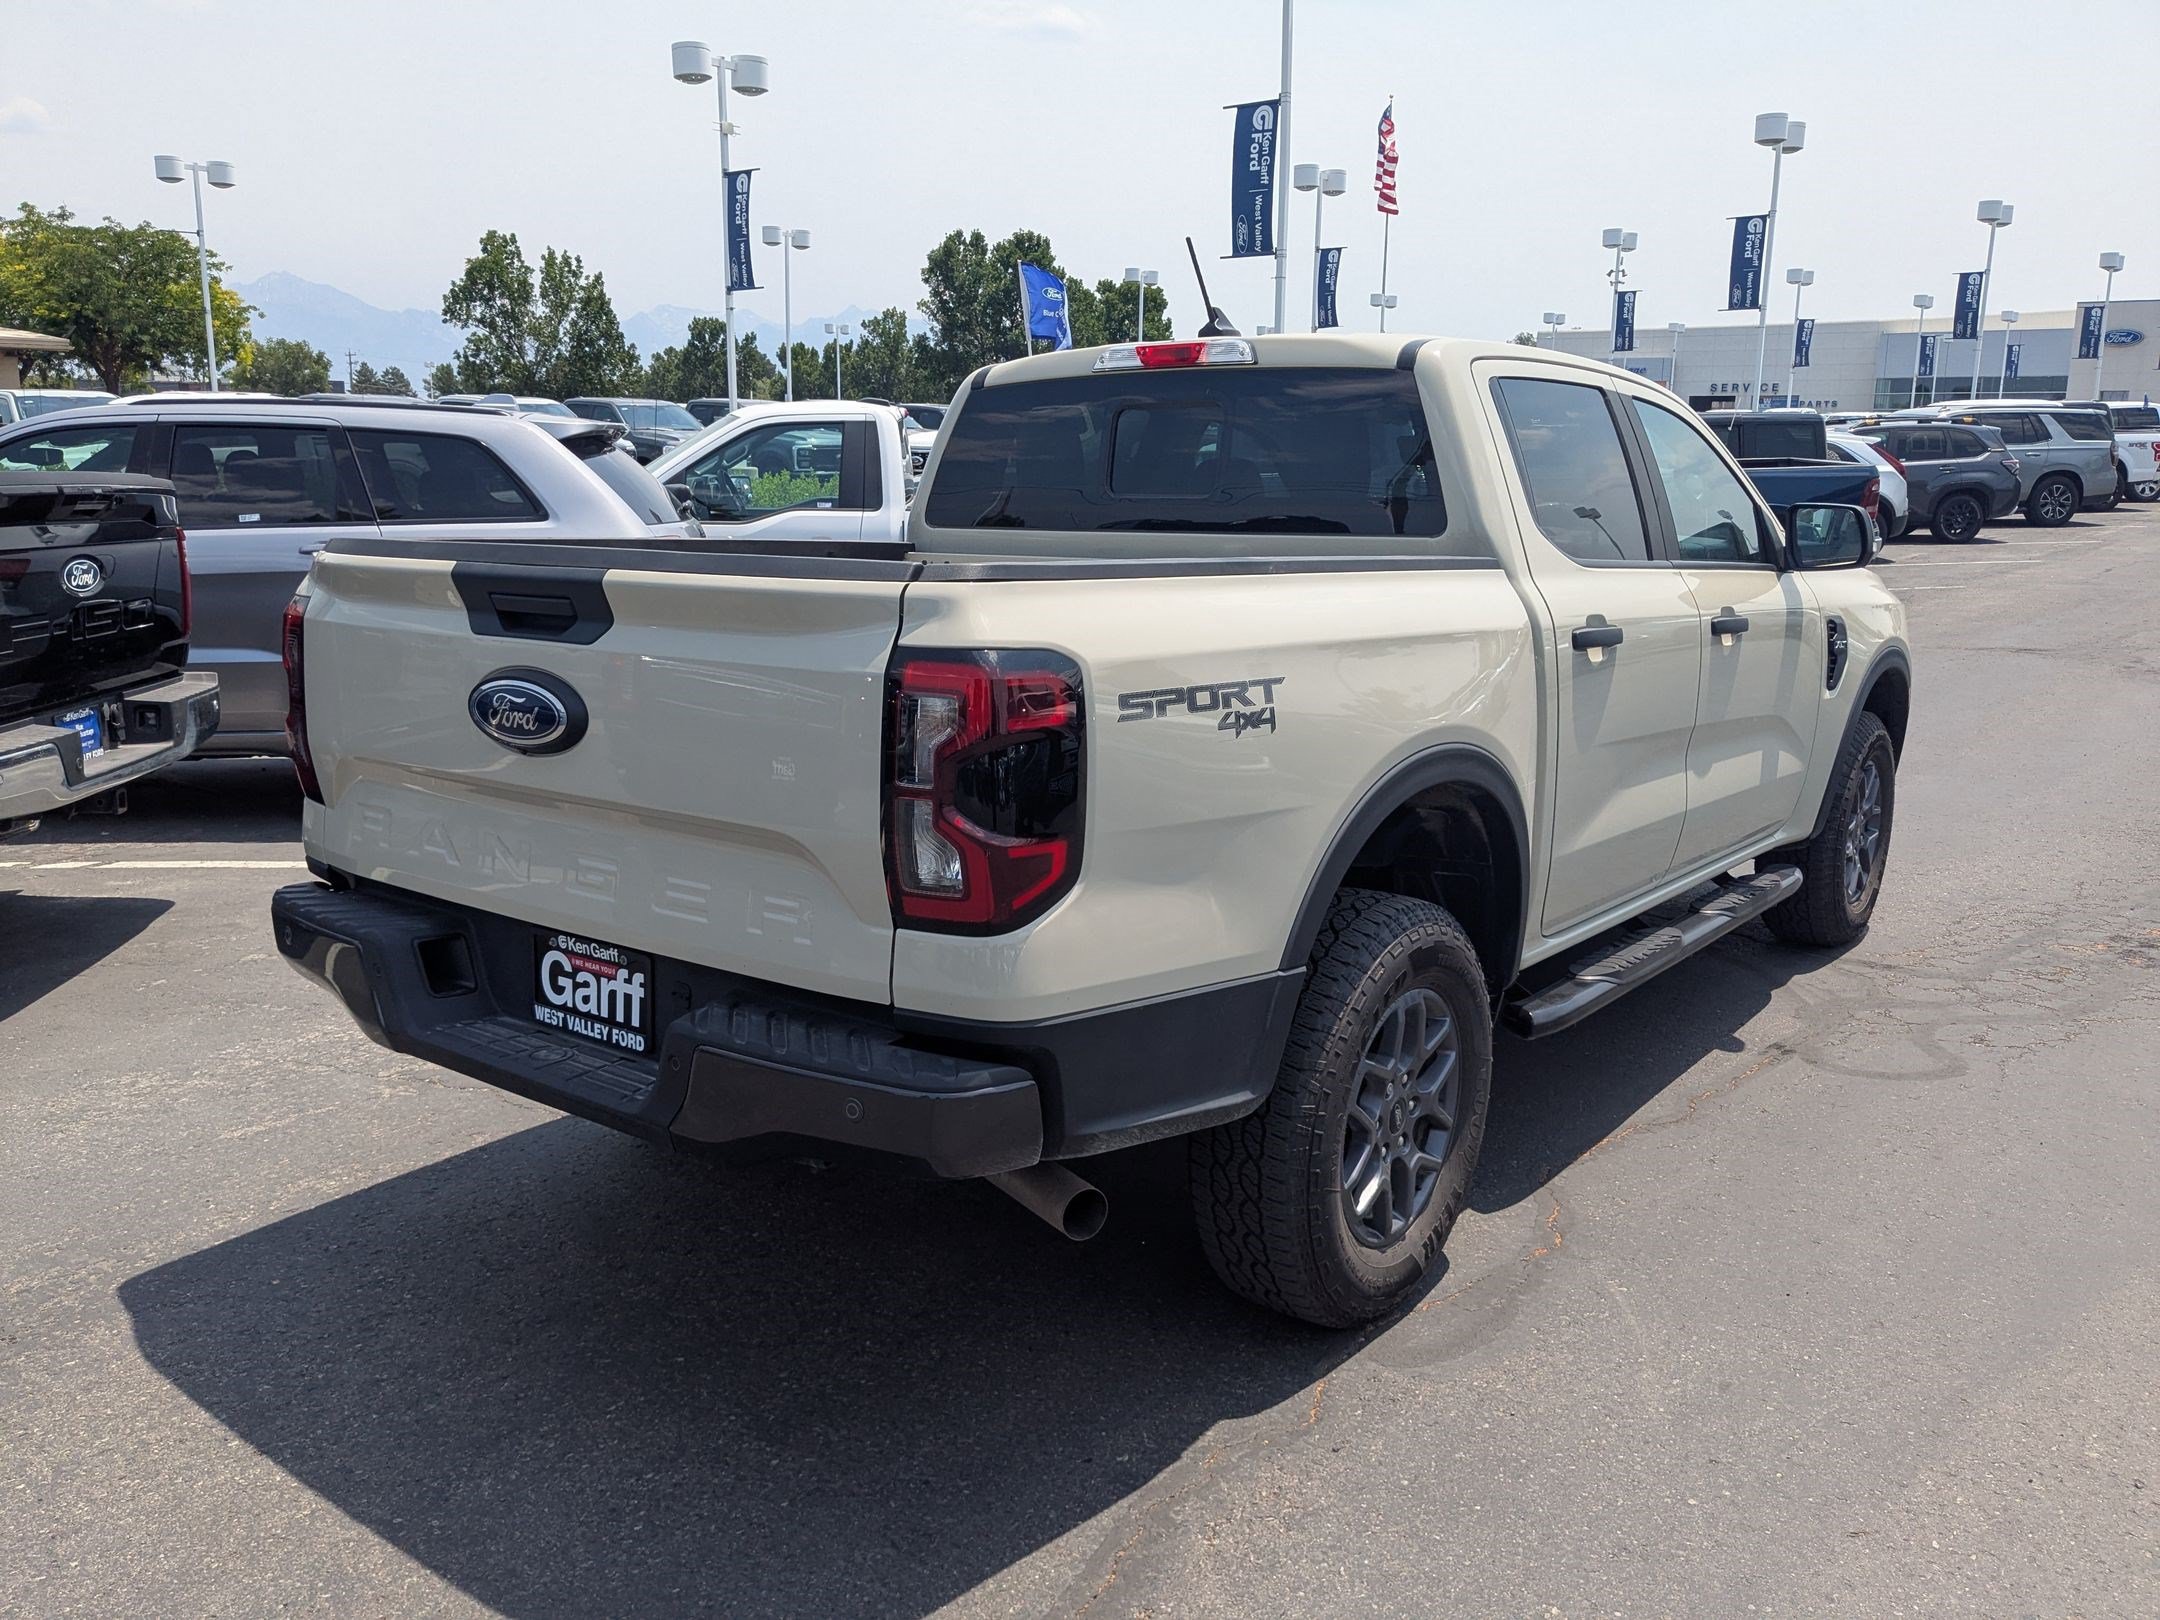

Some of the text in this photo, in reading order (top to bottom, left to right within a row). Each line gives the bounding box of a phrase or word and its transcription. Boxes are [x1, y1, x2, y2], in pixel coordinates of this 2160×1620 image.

[1249, 133, 1262, 171] Ford
[1260, 132, 1272, 185] Ken Garff
[1238, 220, 1247, 246] Ford
[1254, 194, 1262, 252] West Valley
[1744, 234, 1755, 258] Ford
[1752, 234, 1762, 267] Ken Garff
[1046, 287, 1062, 298] Ford
[1745, 289, 1753, 308] Valley
[1965, 285, 1974, 303] Ford
[2106, 332, 2134, 343] Ford
[1710, 383, 1779, 392] SERVCE
[1800, 400, 1838, 408] PARTS
[71, 564, 95, 586] Ford
[488, 692, 540, 731] Ford
[1117, 676, 1286, 723] SPORT
[1217, 706, 1277, 739] 4x4
[352, 802, 815, 945] RANGER
[567, 936, 619, 963] Ken Garff
[575, 959, 584, 967] WE
[584, 961, 600, 971] HEAR
[541, 950, 645, 1028] Garff
[534, 1004, 645, 1052] WEST VALLEY FORD
